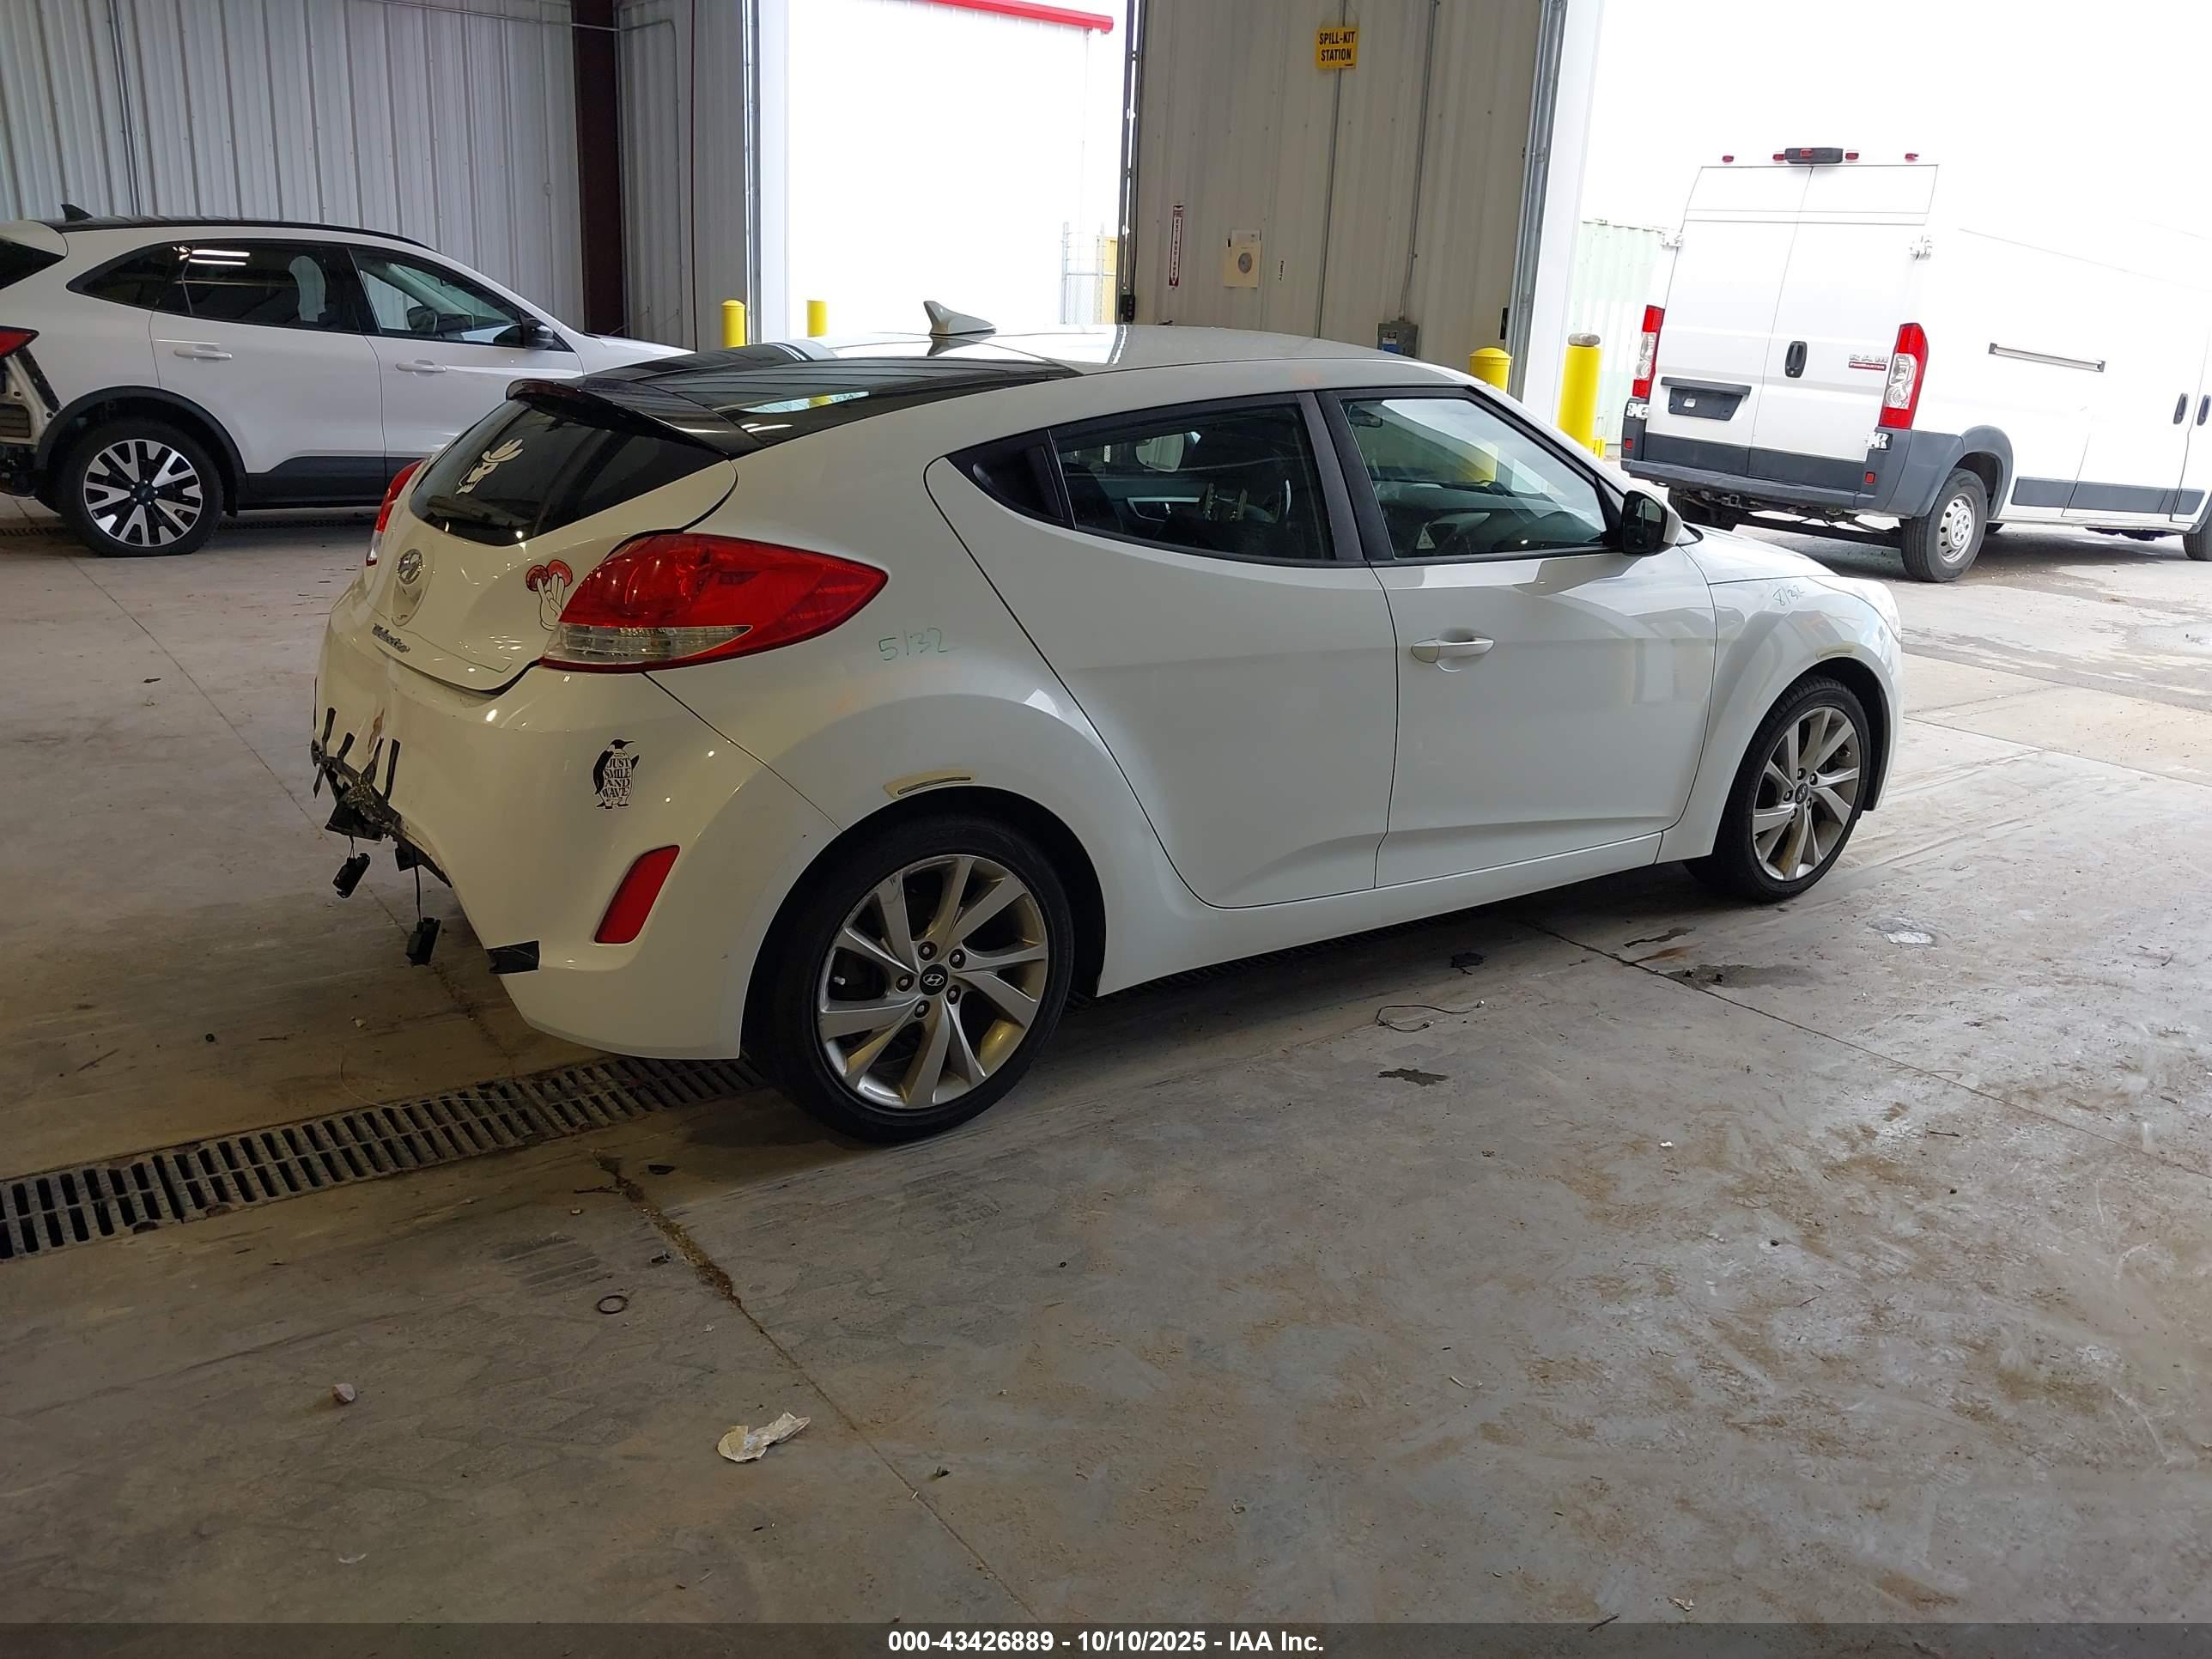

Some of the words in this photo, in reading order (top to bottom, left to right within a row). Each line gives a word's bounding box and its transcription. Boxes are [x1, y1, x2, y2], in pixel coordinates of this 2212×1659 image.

[1319, 31, 1356, 45] SPILL-KIT
[1321, 48, 1352, 61] STATION
[606, 757, 630, 769] JUST
[604, 768, 631, 780] SMILE
[605, 778, 630, 787] AND
[602, 787, 630, 798] WAVE
